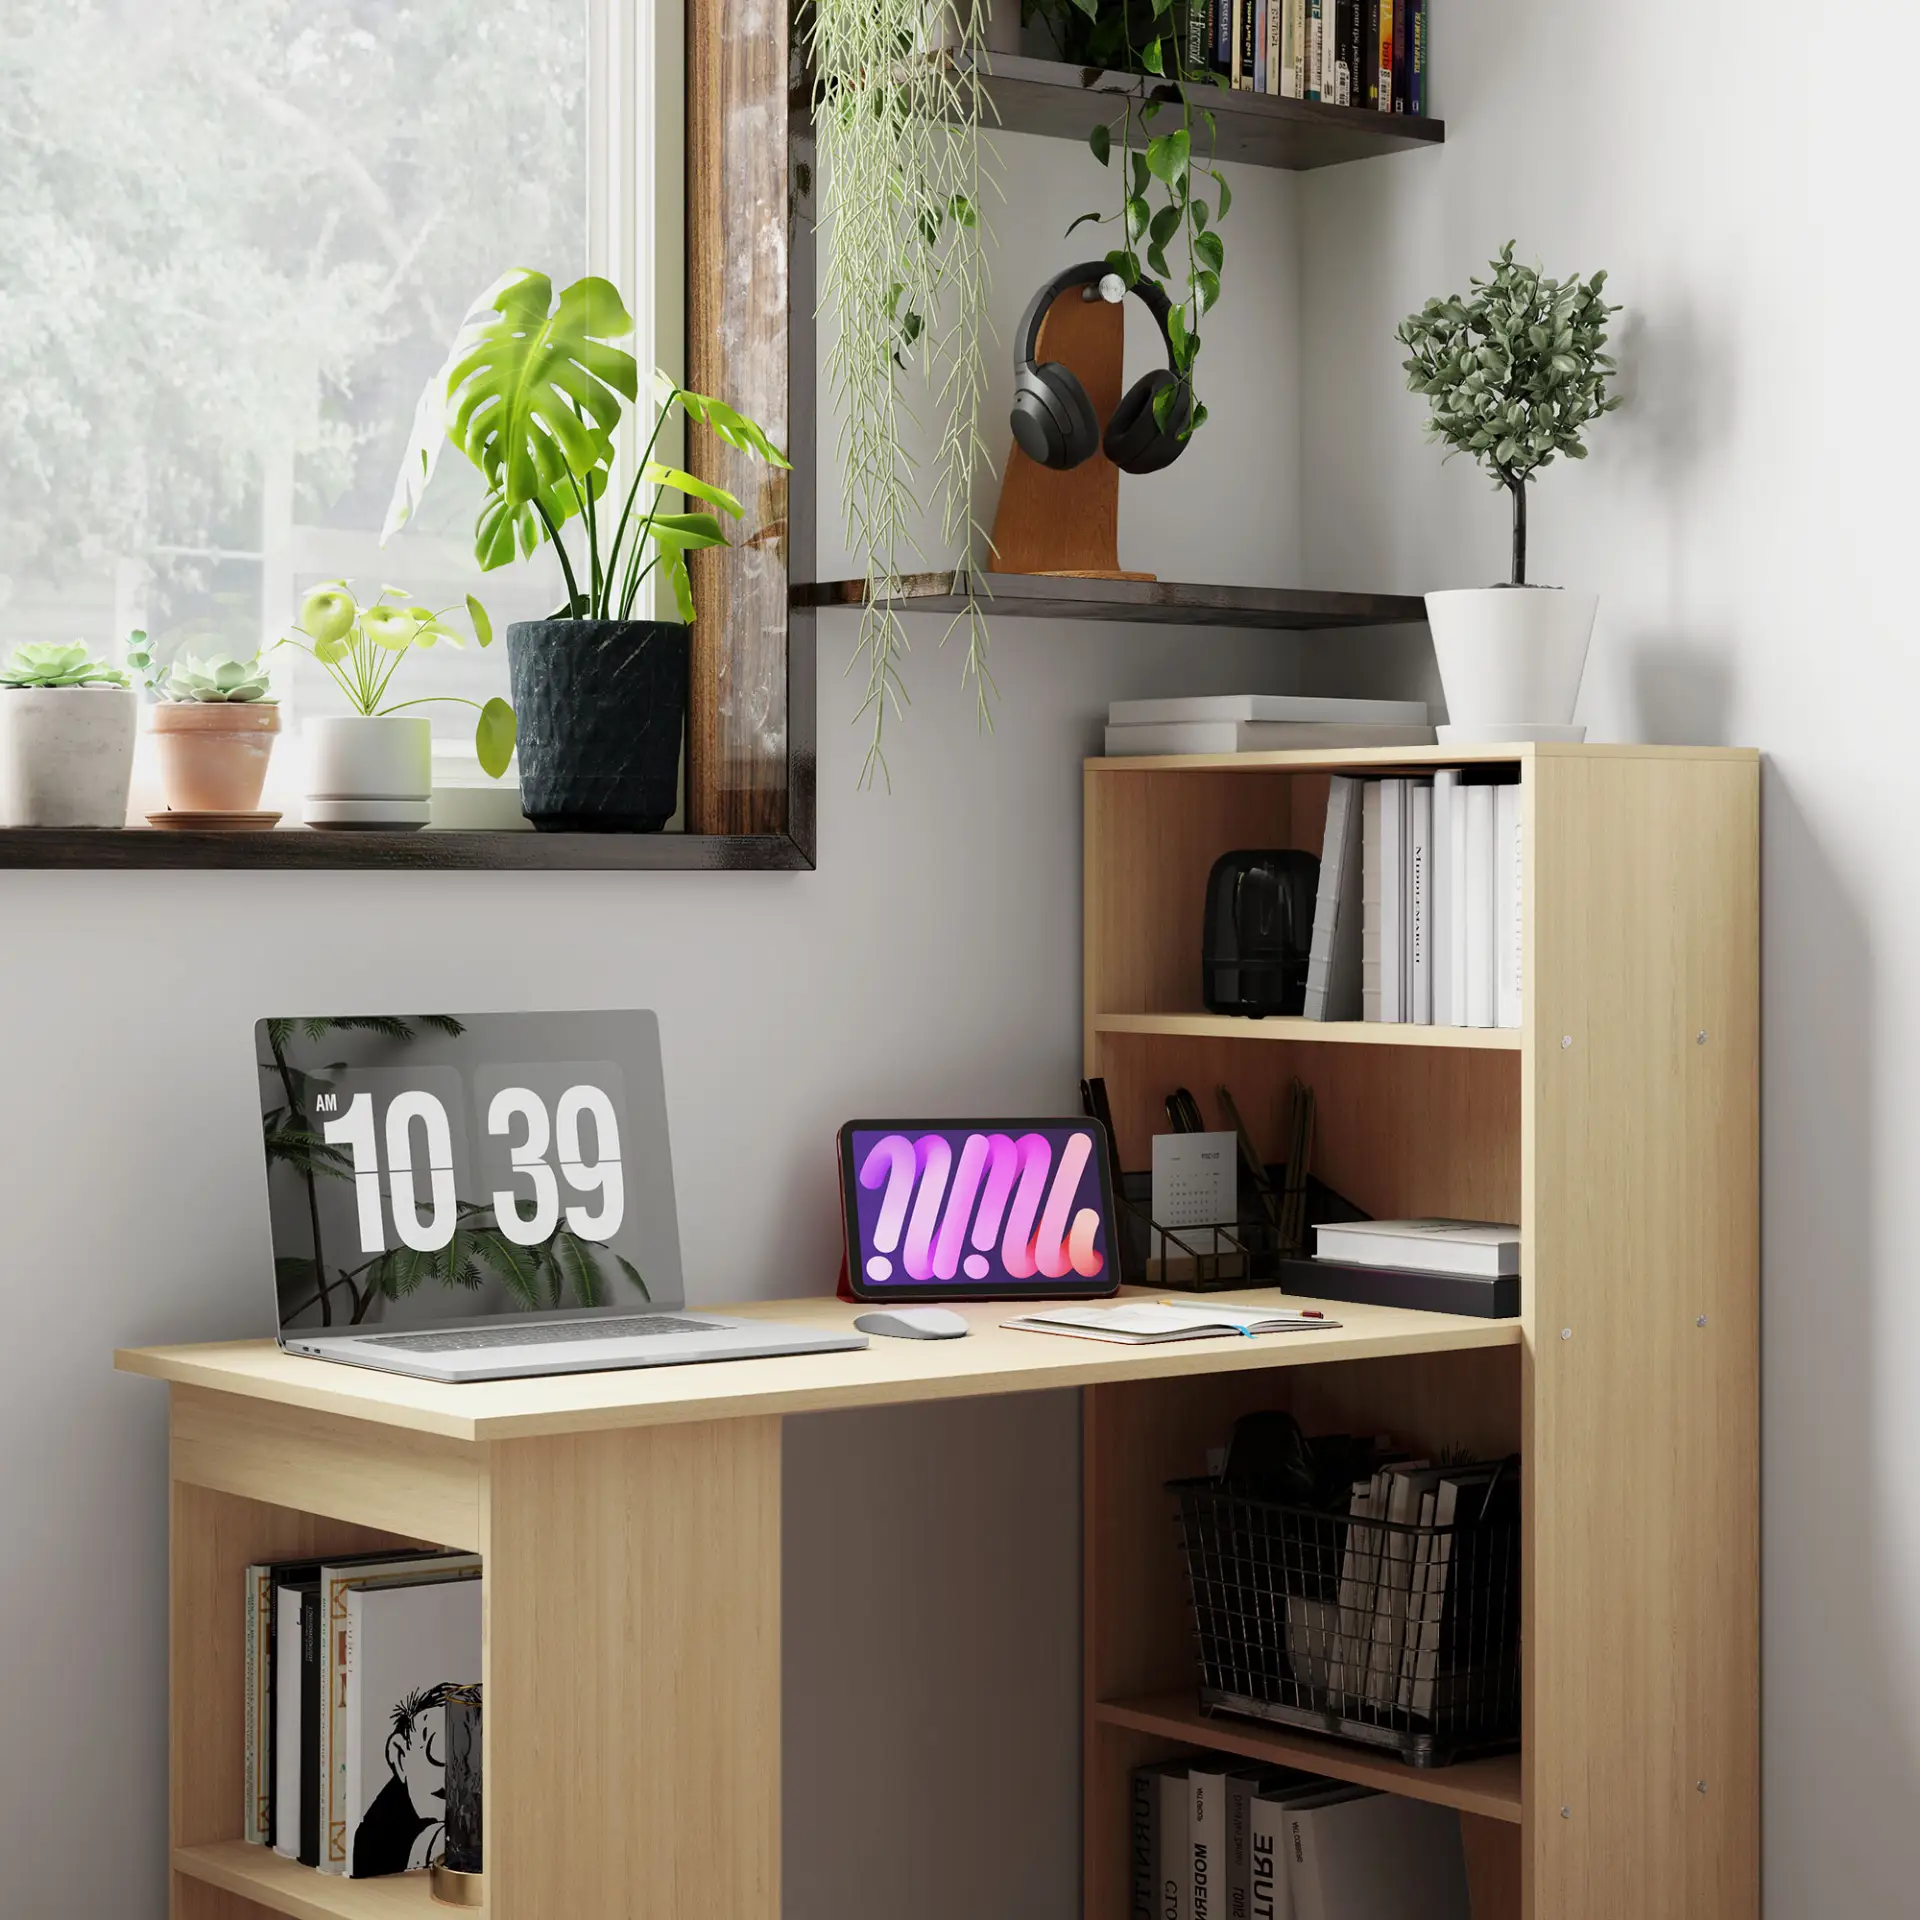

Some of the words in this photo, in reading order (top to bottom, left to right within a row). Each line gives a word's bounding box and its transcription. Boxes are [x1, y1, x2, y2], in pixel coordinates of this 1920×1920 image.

[316, 1094, 337, 1111] AM
[323, 1091, 457, 1252] 10
[488, 1085, 625, 1246] 39
